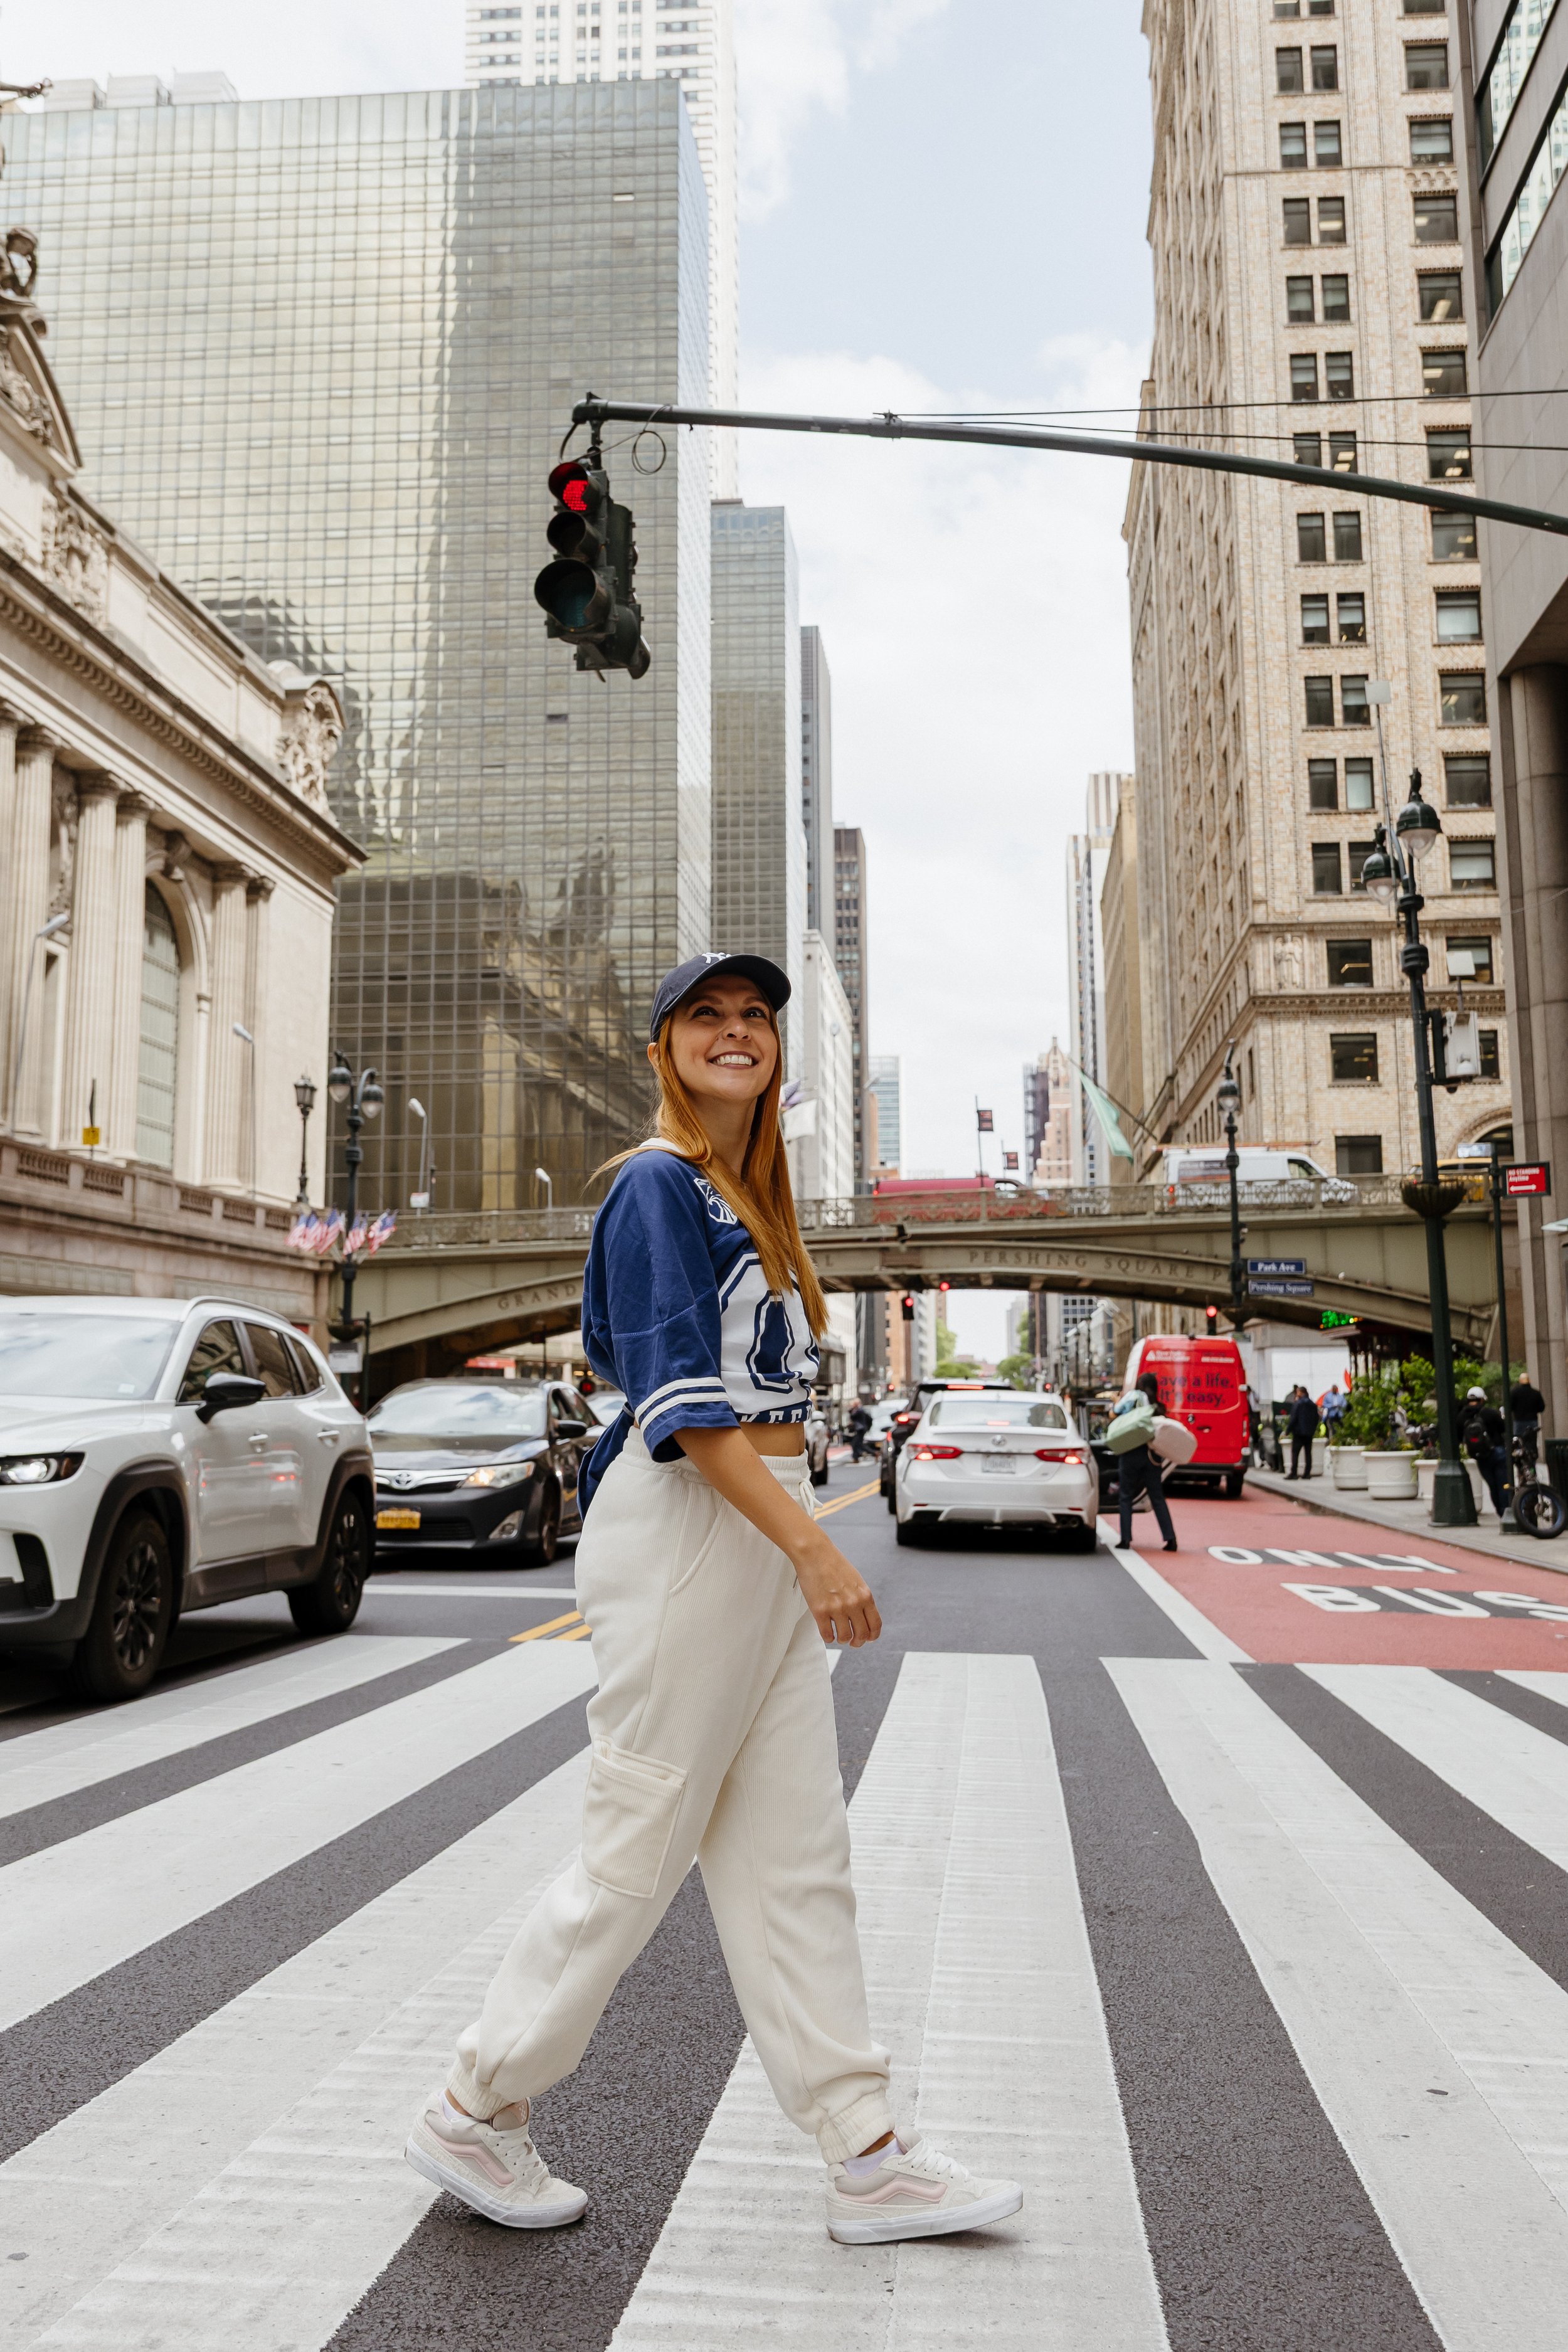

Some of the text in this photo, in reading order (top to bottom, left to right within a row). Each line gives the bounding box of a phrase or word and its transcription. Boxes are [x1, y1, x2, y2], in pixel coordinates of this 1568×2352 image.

[969, 1251, 1087, 1268] PERSHING
[1104, 1257, 1194, 1279] SQUARE
[1258, 1262, 1296, 1272] Park Ave
[497, 1283, 576, 1311] GRAND
[1251, 1283, 1312, 1294] Pershing Square
[1158, 1372, 1234, 1389] ave a life.
[1187, 1392, 1226, 1407] easy.
[1207, 1546, 1459, 1574] ONLY
[1280, 1582, 1568, 1622] BUS
